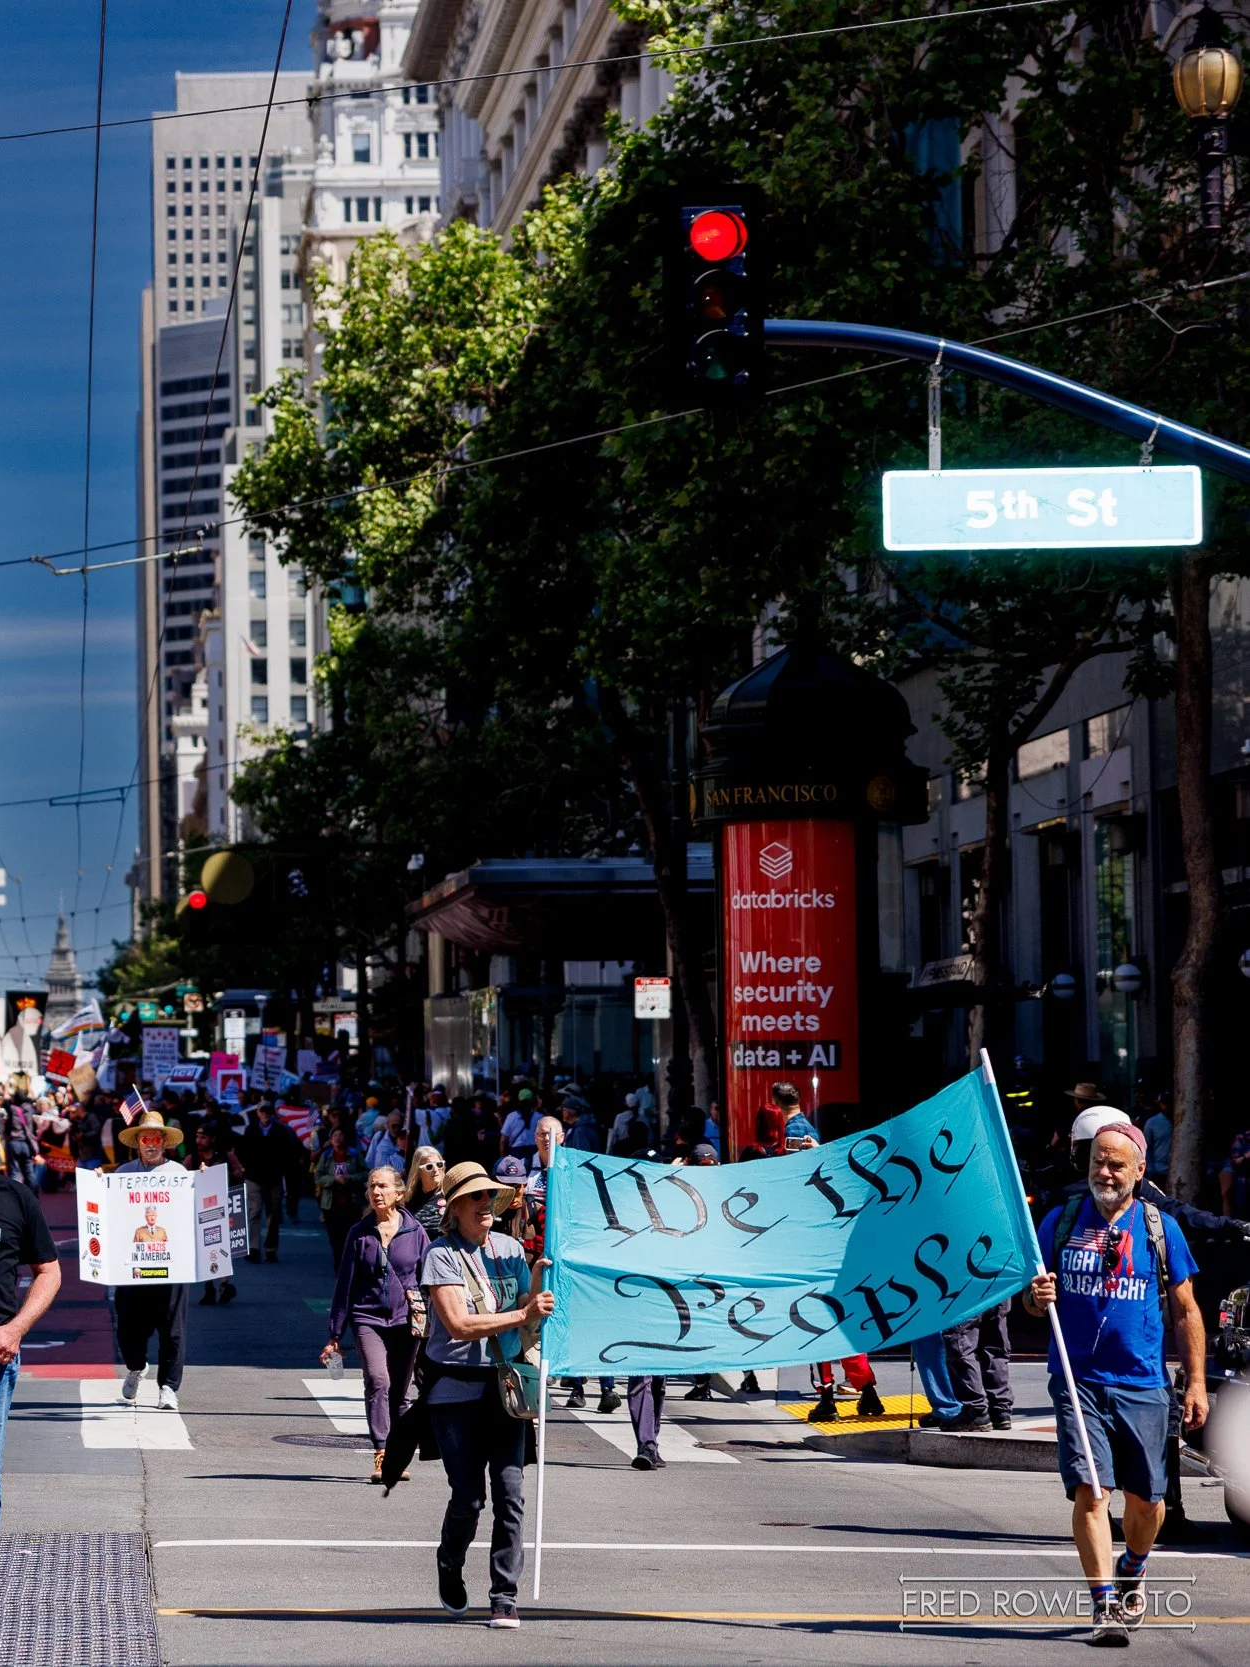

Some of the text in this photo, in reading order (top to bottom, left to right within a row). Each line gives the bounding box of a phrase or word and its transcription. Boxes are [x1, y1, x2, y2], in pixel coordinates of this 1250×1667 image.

[966, 488, 1118, 528] 5th St
[706, 784, 837, 808] SAN FRANCISCO
[731, 888, 835, 909] databricks
[740, 951, 822, 973] Where
[734, 980, 834, 1008] security
[741, 1011, 821, 1031] meets
[733, 1044, 780, 1067] data
[807, 1044, 836, 1066] AI
[578, 1121, 976, 1247] We the
[129, 1191, 170, 1204] NO KINGS
[87, 1221, 100, 1236] ICE
[136, 1243, 166, 1252] NO NAZIS
[230, 1239, 245, 1249] APO
[131, 1252, 171, 1261] IN AMERICA
[1061, 1250, 1104, 1273] FIGHT
[598, 1231, 1013, 1363] People
